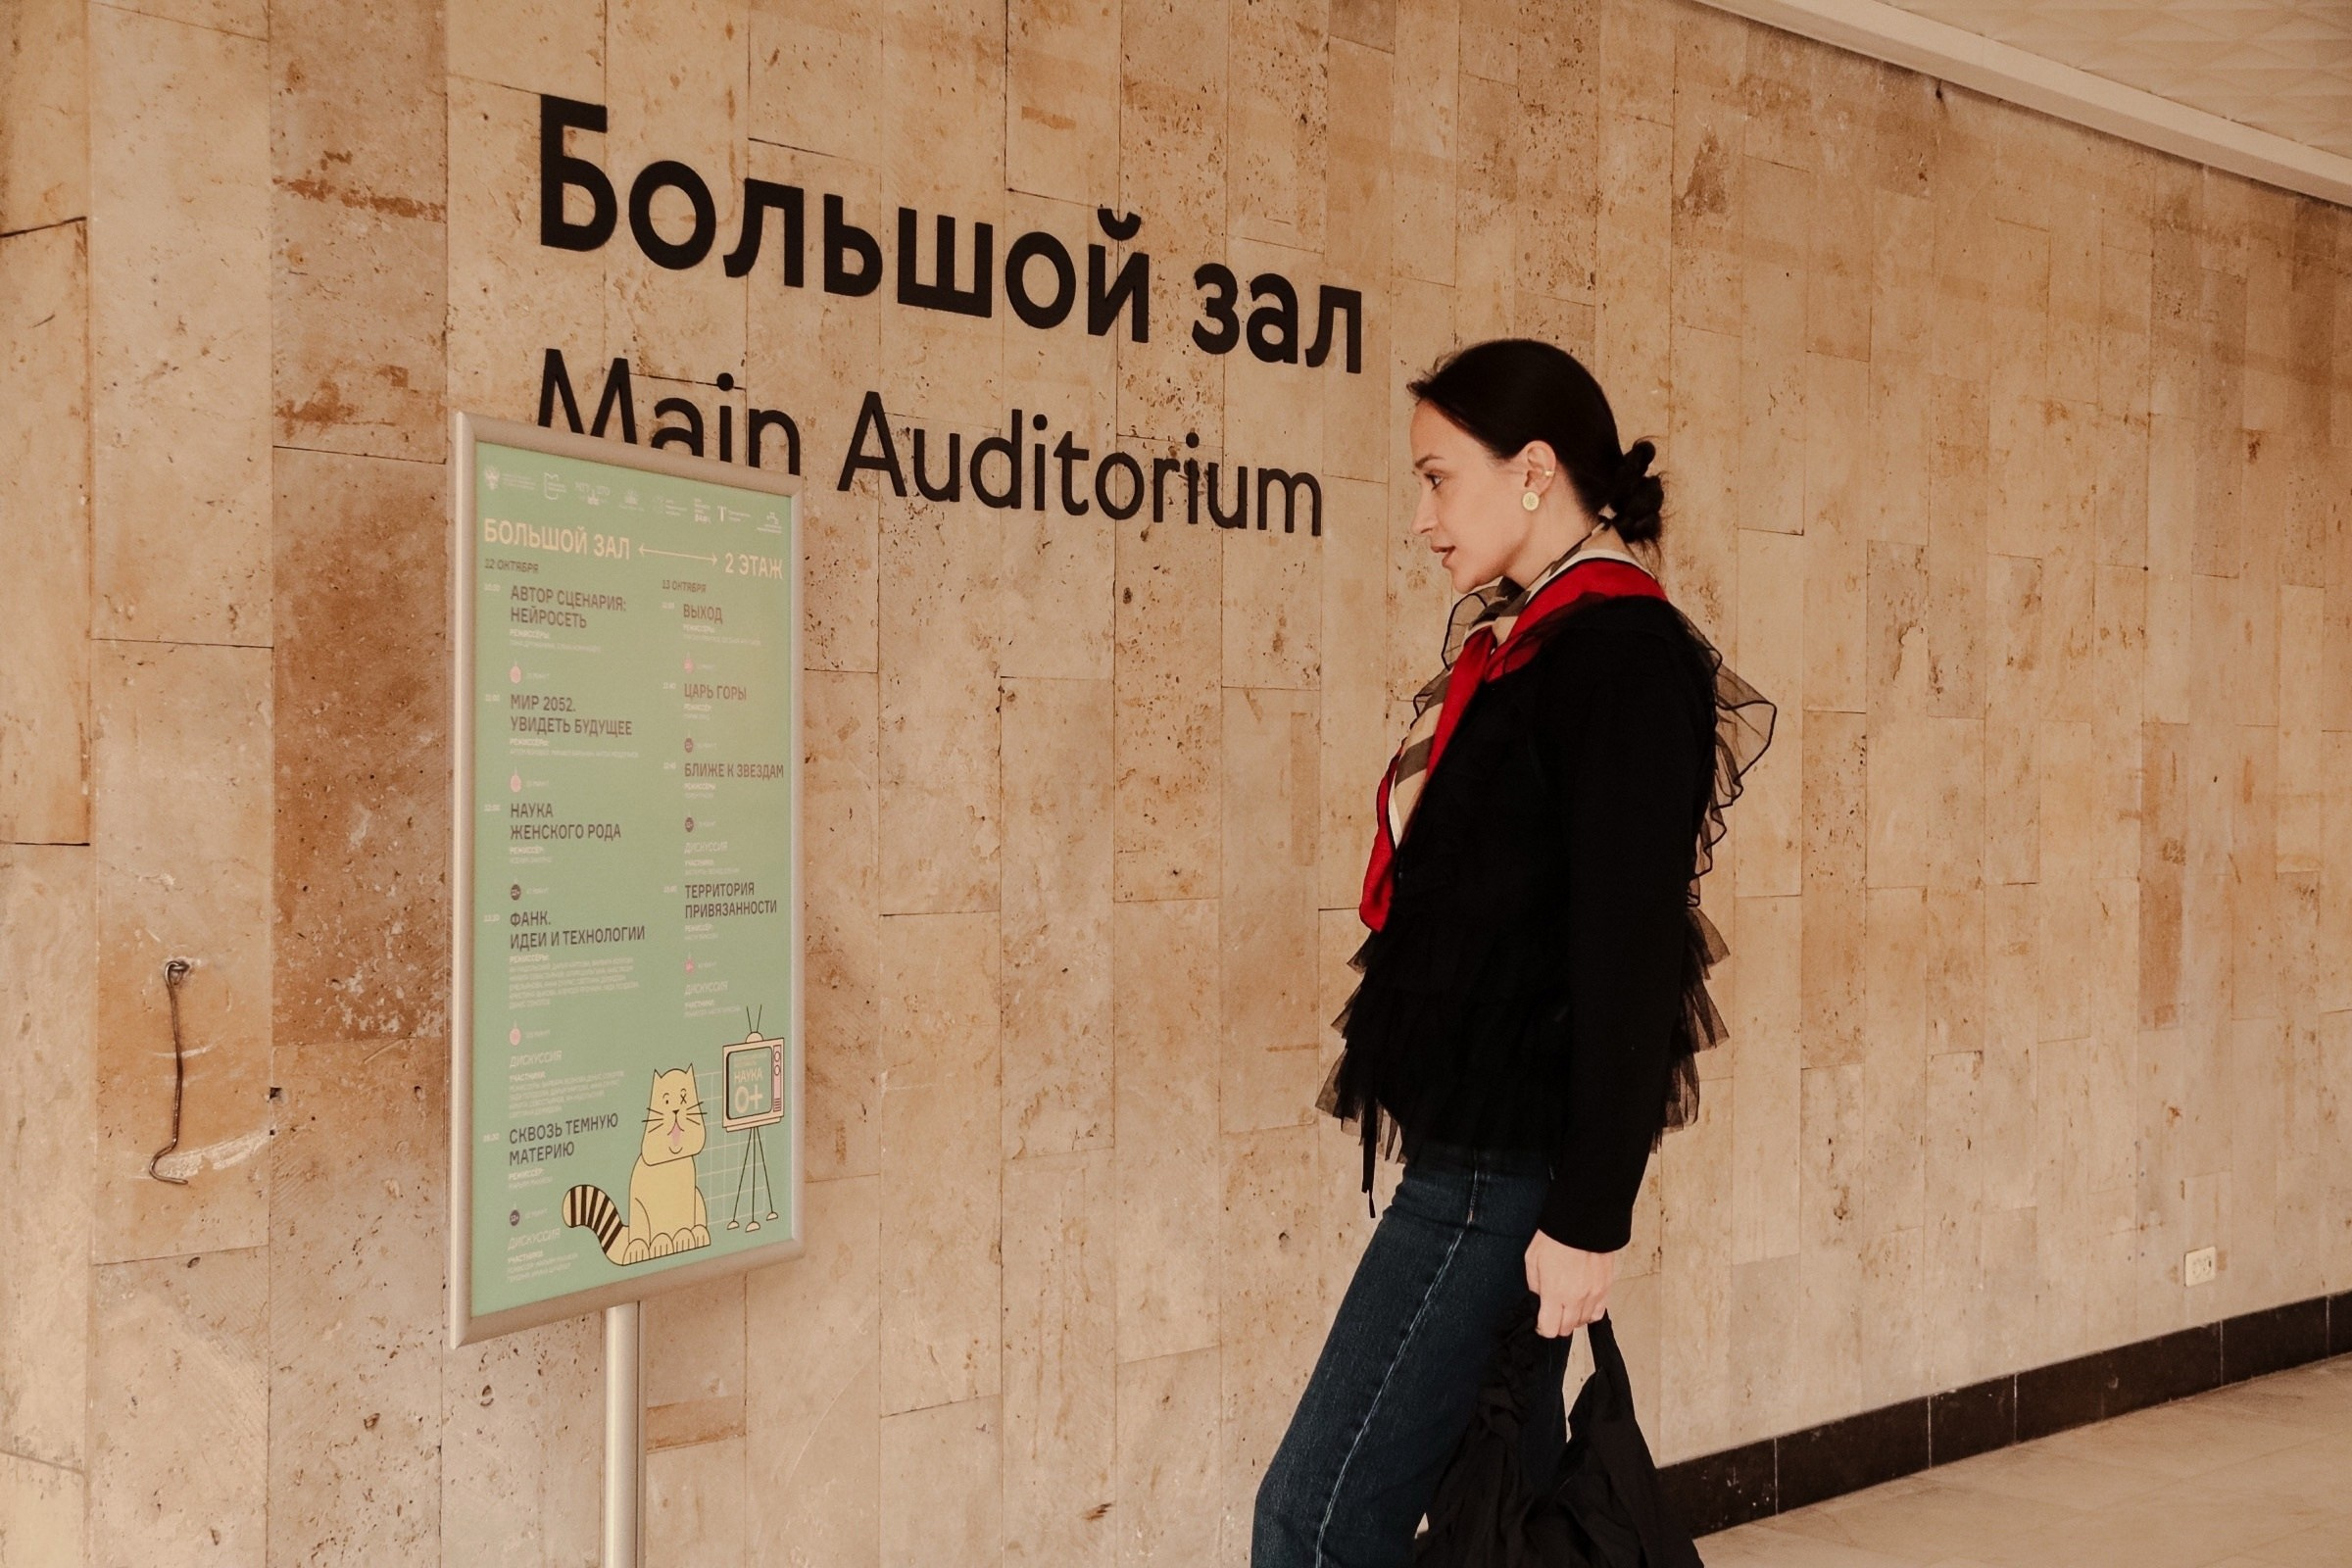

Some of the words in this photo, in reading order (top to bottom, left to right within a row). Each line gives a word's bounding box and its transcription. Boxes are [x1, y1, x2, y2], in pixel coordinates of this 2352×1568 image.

[539, 95, 1151, 343] Большой
[1193, 264, 1362, 373] зал
[538, 348, 801, 476] Main
[838, 392, 1322, 537] Auditorium
[484, 518, 588, 555] БОЛЬШОЙ
[594, 534, 630, 560] ЗАЛ
[725, 553, 734, 574] 2
[739, 554, 783, 579] ЭТАЖ
[497, 560, 539, 573] ОКТЯБРЯ
[672, 581, 706, 593] ОКТЯБРЯ
[511, 585, 554, 603] АВТОР
[557, 590, 626, 612] СЦЕНАРИЯ:
[511, 606, 587, 628] НЕЙРОСЕТЬ
[683, 604, 722, 624] ВЫХОД
[684, 684, 713, 702] ЦАРЬ
[717, 686, 747, 701] ГОРЫ
[511, 694, 539, 710] МИР
[543, 696, 576, 712] 2052.
[511, 716, 570, 734] УВИДЕТЬ
[574, 719, 632, 737] БУДУЩЕЕ
[684, 762, 724, 778] БЛИЖЕ
[727, 763, 734, 777] К
[736, 764, 784, 781] ЗВЕЗДАМ
[510, 803, 554, 818] НАУКА
[510, 824, 584, 840] ЖЕНСКОГО
[588, 824, 621, 842] РОДА
[685, 882, 755, 899] ТЕРРИТОРИЯ
[510, 910, 552, 927] ФАНК.
[685, 900, 777, 918] ПРИВЯЗАННОСТИ
[510, 932, 547, 952] ИДЕИ
[551, 931, 560, 947] И
[563, 925, 645, 946] ТЕХНОЛОГИИ
[735, 1067, 762, 1083] НАУКА
[735, 1084, 763, 1113] 0+
[510, 1123, 563, 1145] СКВОЗЬ
[565, 1112, 618, 1135] ТЕМНУЮ
[510, 1141, 574, 1166] МАТЕРИЮ
